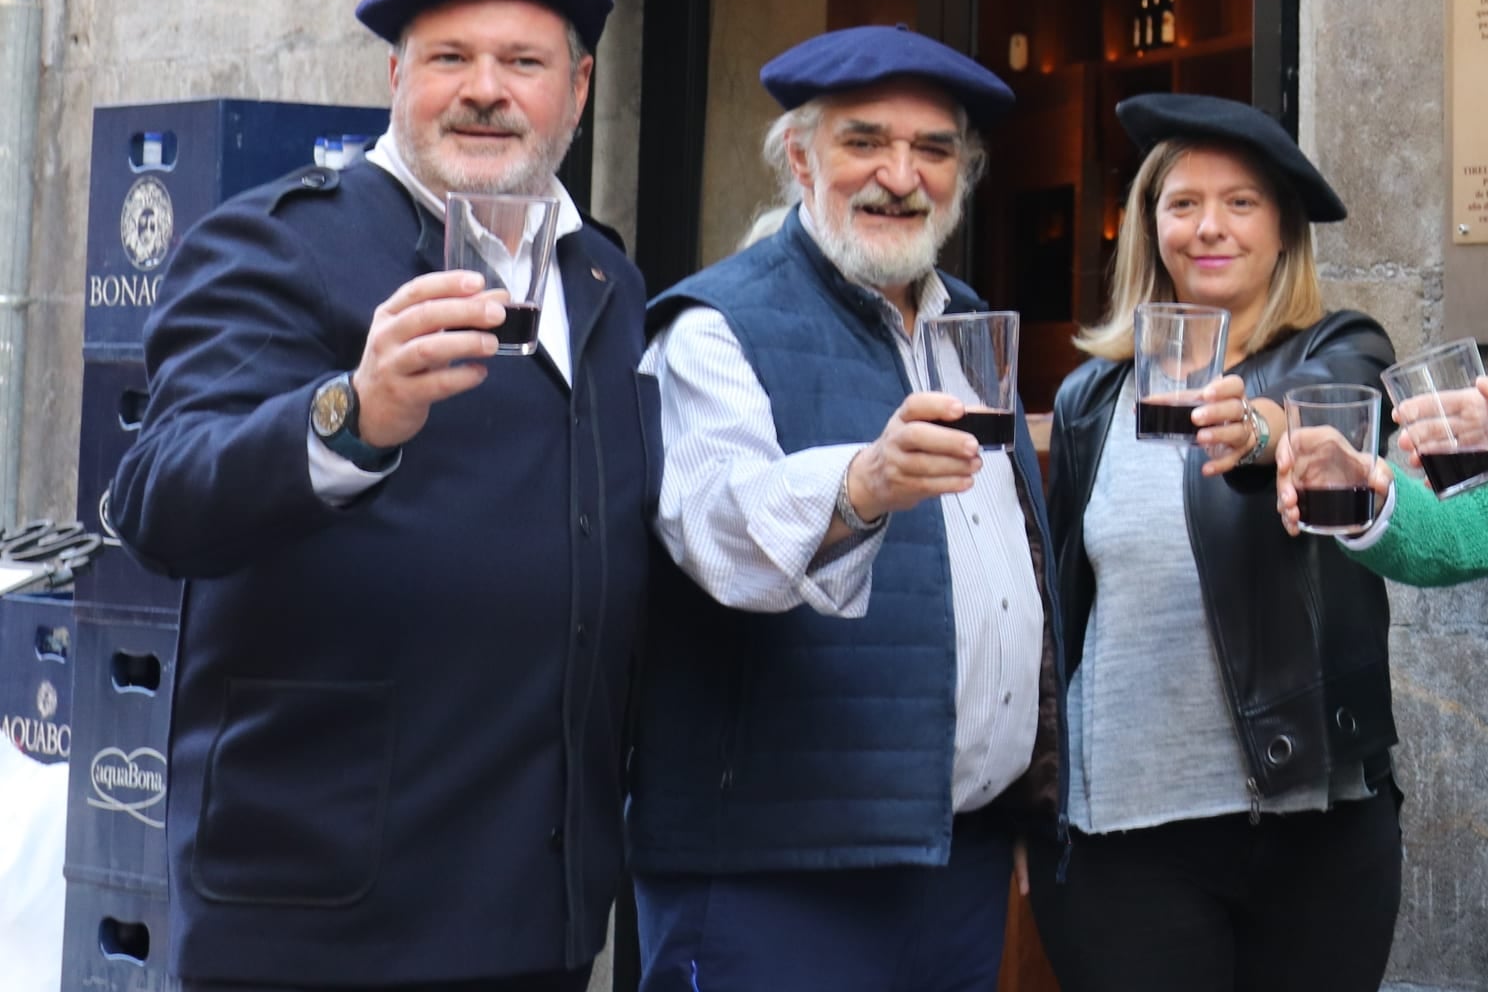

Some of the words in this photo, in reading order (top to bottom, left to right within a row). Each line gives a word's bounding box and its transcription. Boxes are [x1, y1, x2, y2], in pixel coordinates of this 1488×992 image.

[1475, 190, 1483, 198] de
[1468, 202, 1481, 211] afin
[1, 714, 72, 757] AQUABO
